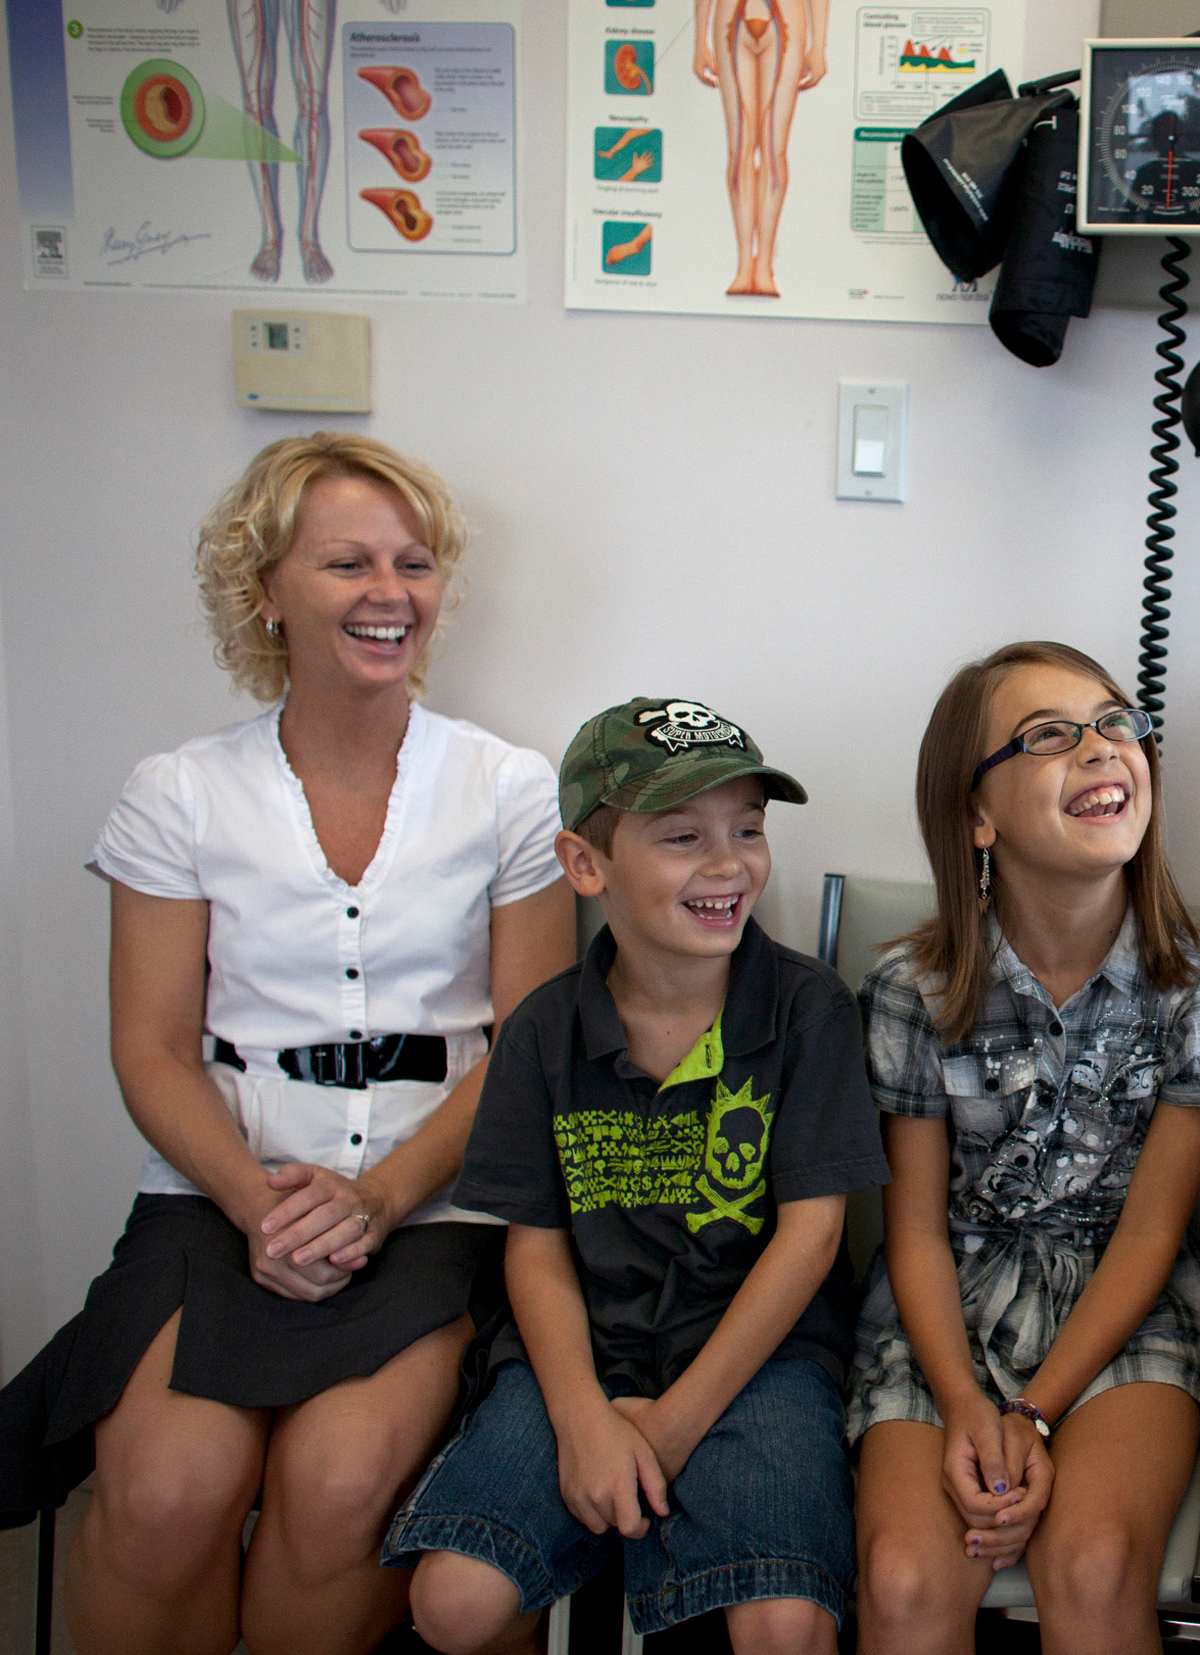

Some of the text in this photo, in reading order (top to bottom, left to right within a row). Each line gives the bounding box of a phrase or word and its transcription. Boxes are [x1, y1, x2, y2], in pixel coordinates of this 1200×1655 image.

[350, 31, 421, 43] Atherosclerosis
[1125, 169, 1137, 180] 40
[1141, 185, 1154, 195] 20
[1182, 186, 1200, 197] 300
[663, 725, 691, 740] SUPER
